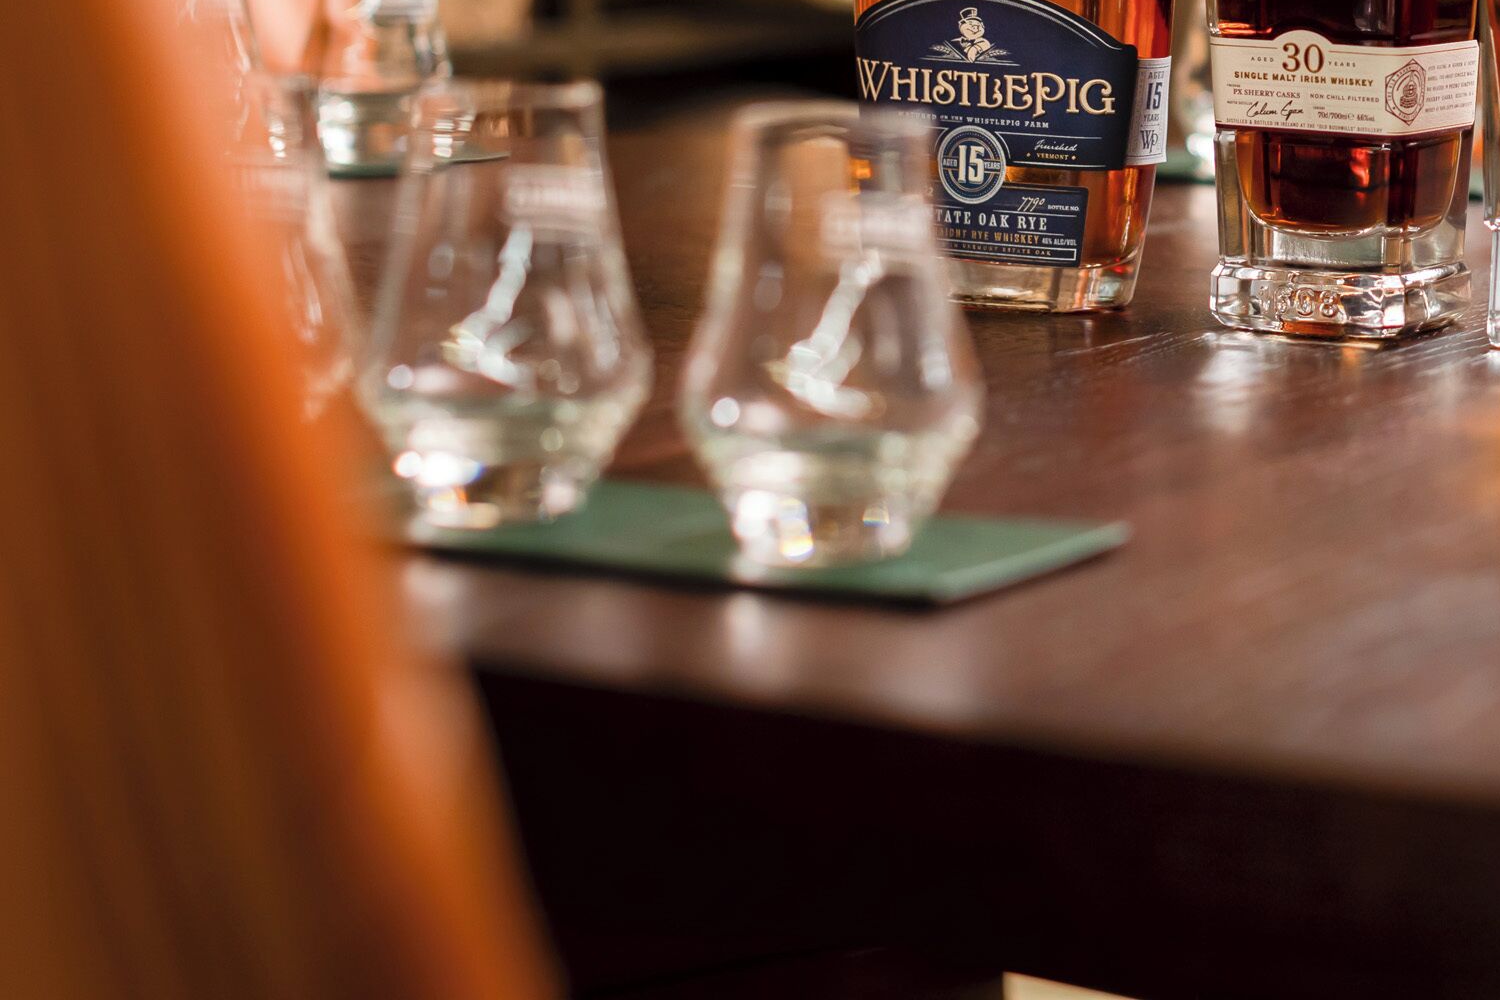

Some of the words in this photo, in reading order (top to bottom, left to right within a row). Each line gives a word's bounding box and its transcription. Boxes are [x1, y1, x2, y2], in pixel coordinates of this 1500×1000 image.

[1281, 42, 1325, 74] 30
[1328, 60, 1357, 68] YEARS
[1234, 71, 1268, 80] SINGLE
[1272, 73, 1296, 82] MALT
[1300, 75, 1327, 84] IRISH
[1330, 77, 1375, 87] WHISKEY
[1146, 82, 1163, 110] 15
[1233, 88, 1243, 96] PX
[1244, 89, 1275, 98] SHERRY
[1276, 91, 1301, 99] CASKS
[1347, 95, 1380, 103] FILTERED
[966, 116, 1020, 127] WHISTLEPIG
[1024, 120, 1049, 129] FARM
[1143, 113, 1160, 122] YEARS
[1036, 152, 1069, 161] VERMONT
[943, 157, 957, 167] AGED
[958, 144, 985, 184] 15
[984, 159, 1001, 169] YEARS
[935, 208, 972, 225] TATE
[978, 212, 1010, 229] OAK
[1017, 215, 1048, 231] RYE
[971, 228, 989, 241] RYE
[993, 231, 1040, 245] WHISKEY
[1035, 249, 1053, 257] OAK
